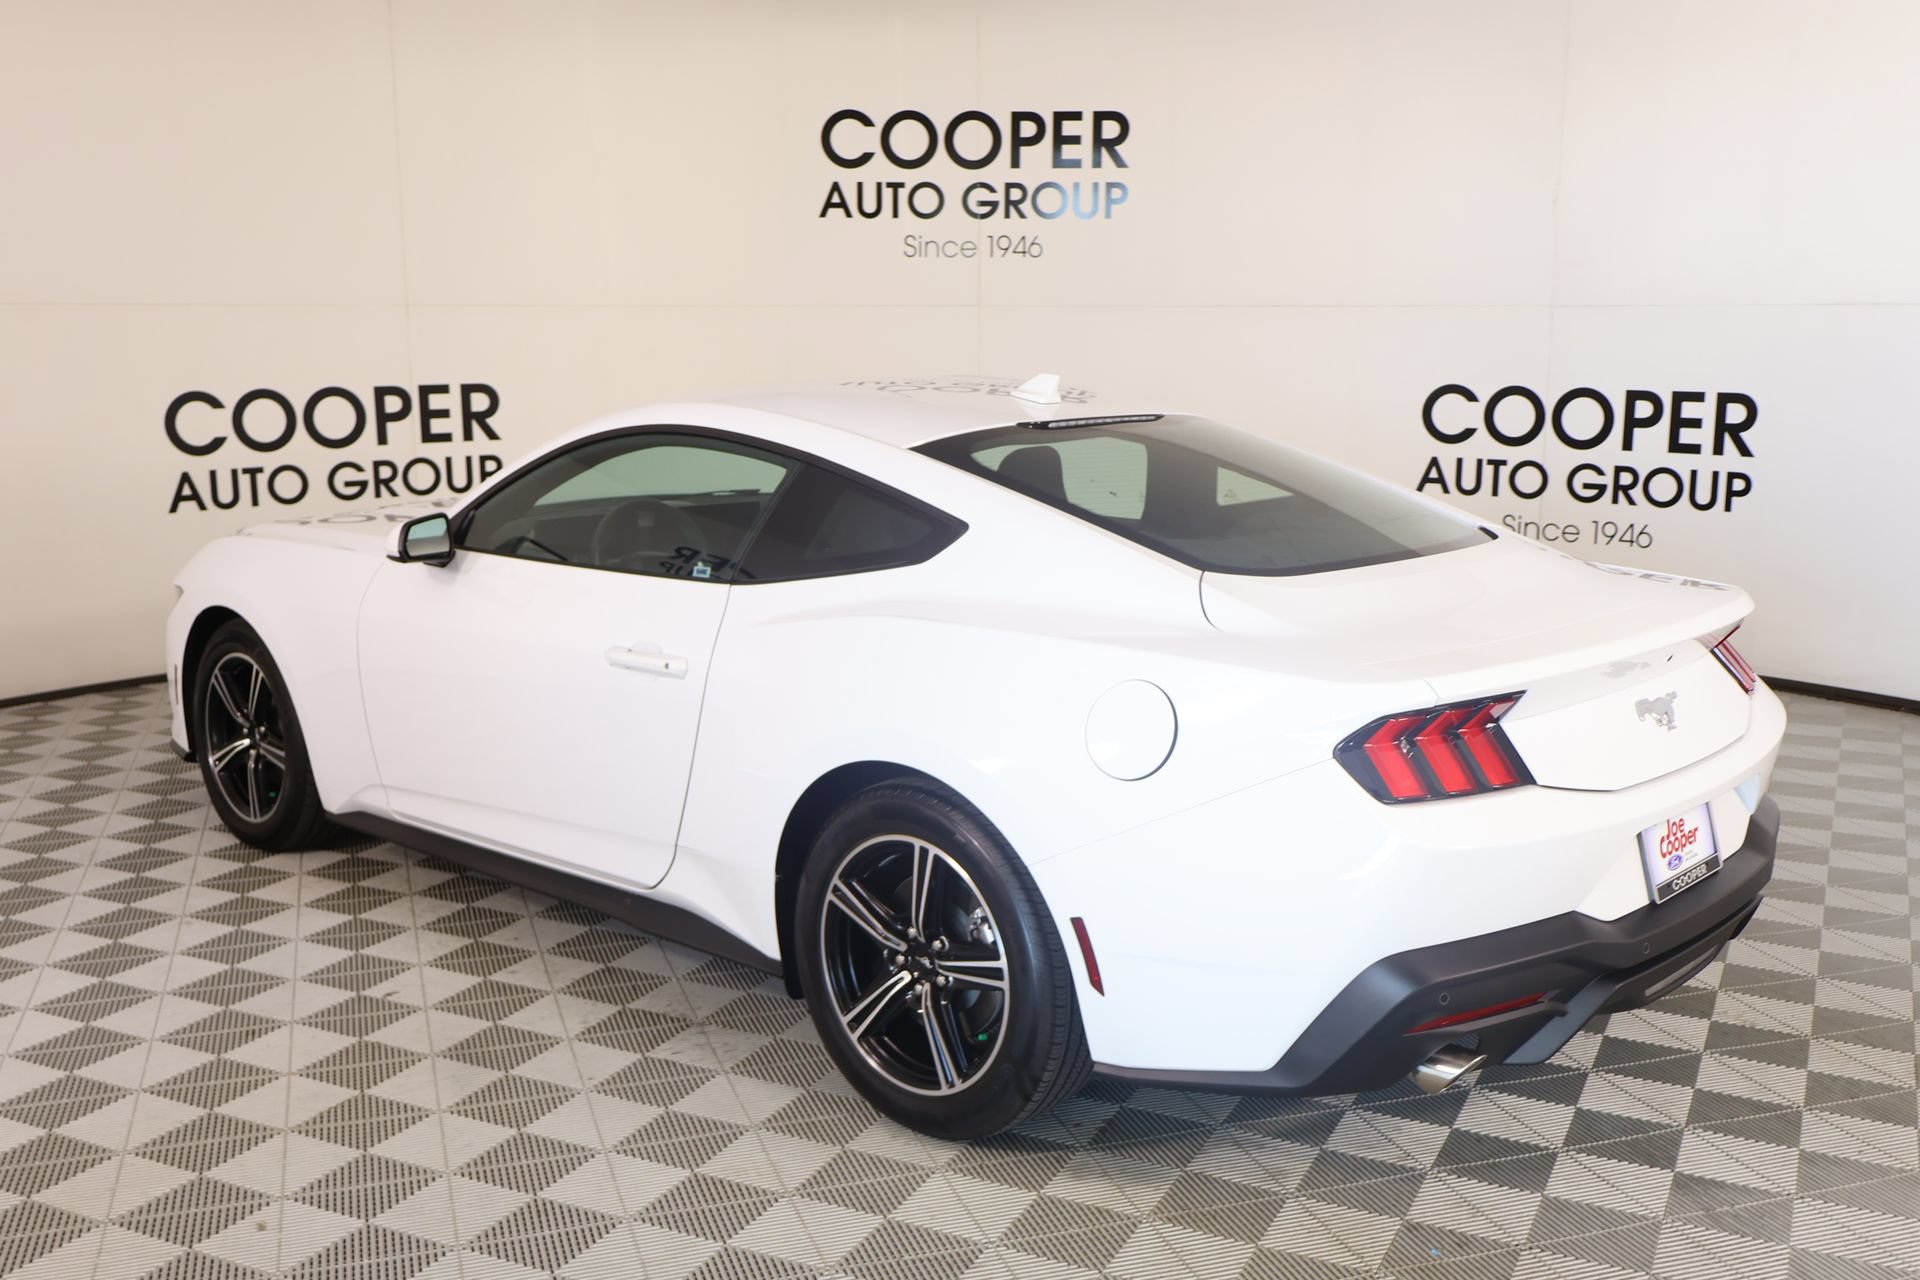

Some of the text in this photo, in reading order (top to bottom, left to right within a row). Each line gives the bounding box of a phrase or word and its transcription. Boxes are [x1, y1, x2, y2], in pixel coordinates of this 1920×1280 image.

[821, 109, 1130, 170] COOPER
[819, 181, 1129, 220] AUTO GROUP
[903, 234, 1043, 259] Since 1946
[164, 383, 502, 456] COOPER
[1422, 383, 1758, 458] COOPER
[168, 455, 503, 513] AUTO GROUP
[1416, 456, 1753, 512] AUTO GROUP
[1502, 514, 1653, 549] Since 1946
[1660, 827, 1698, 858] Cooper
[1666, 818, 1684, 840] Joe
[1673, 864, 1707, 890] COOPER
